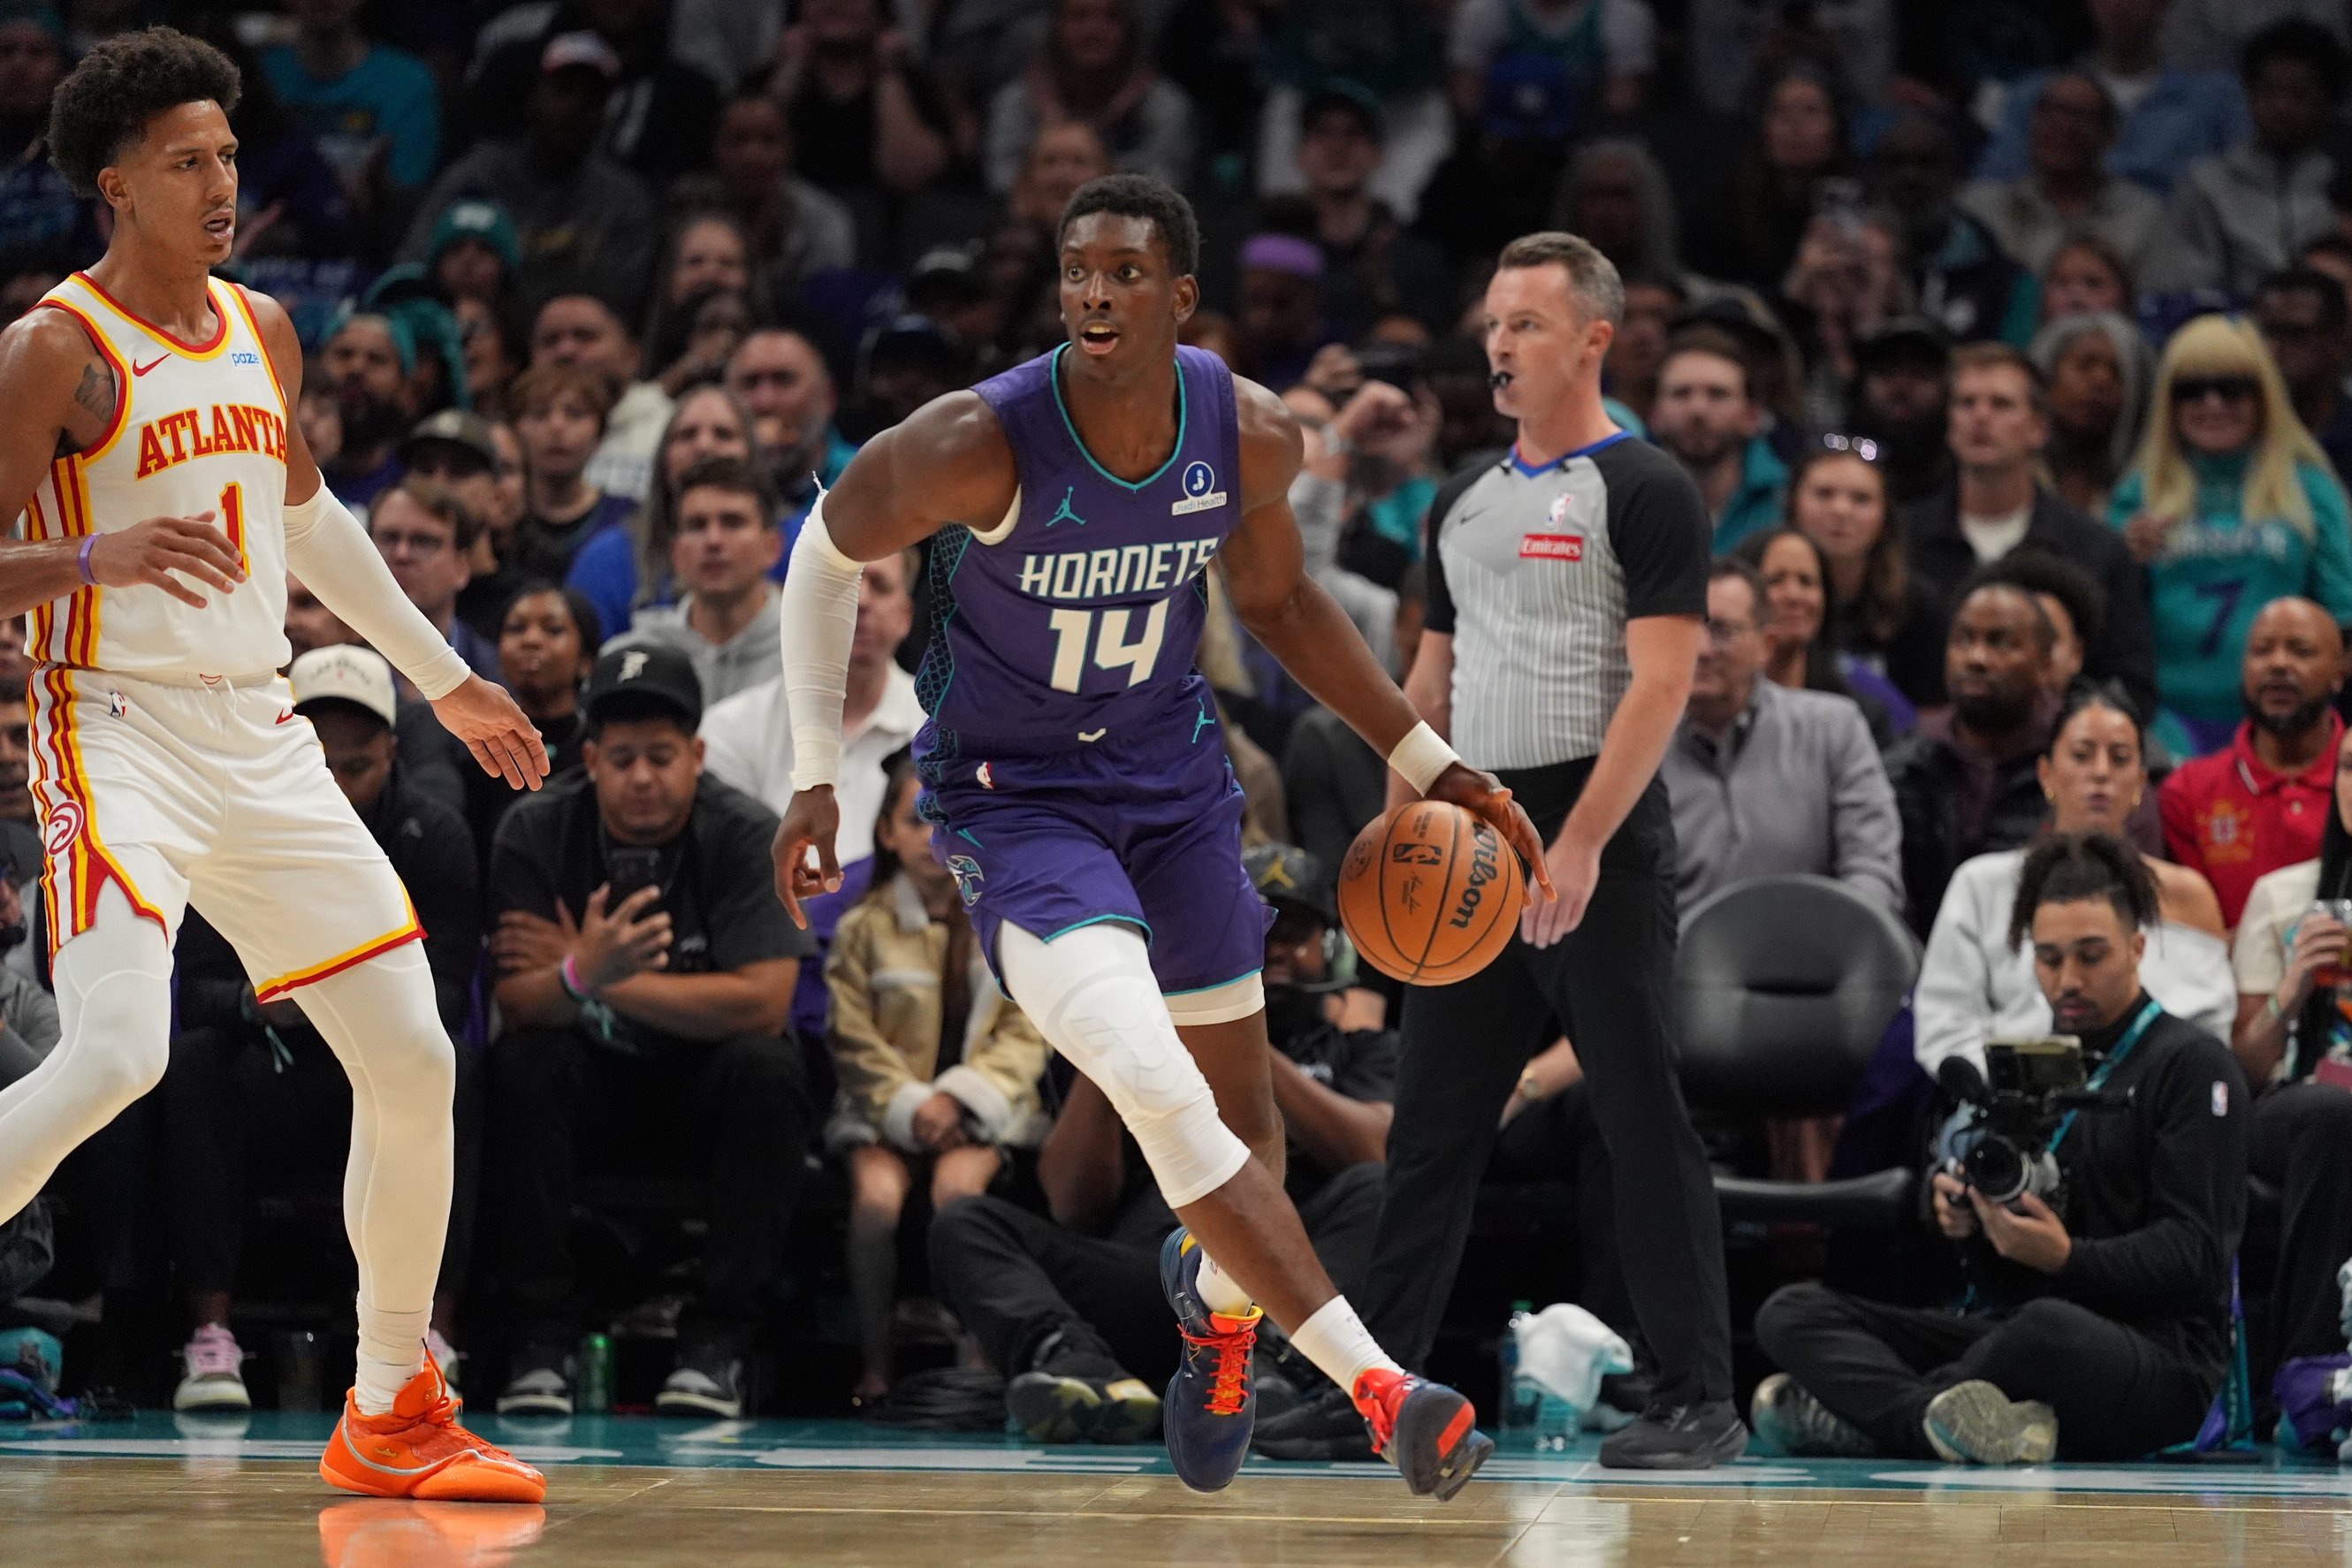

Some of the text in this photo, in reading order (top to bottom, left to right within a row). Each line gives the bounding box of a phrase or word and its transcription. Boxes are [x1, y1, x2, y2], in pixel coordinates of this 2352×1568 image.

[135, 403, 287, 481] ATLANTA
[219, 482, 250, 577] 1
[1175, 494, 1225, 513] Judi Health
[1016, 537, 1219, 598] HORNETS
[1520, 537, 1581, 558] Emirates
[1049, 598, 1170, 694] 14
[2196, 579, 2246, 657] 7
[1450, 819, 1498, 929] Wilson
